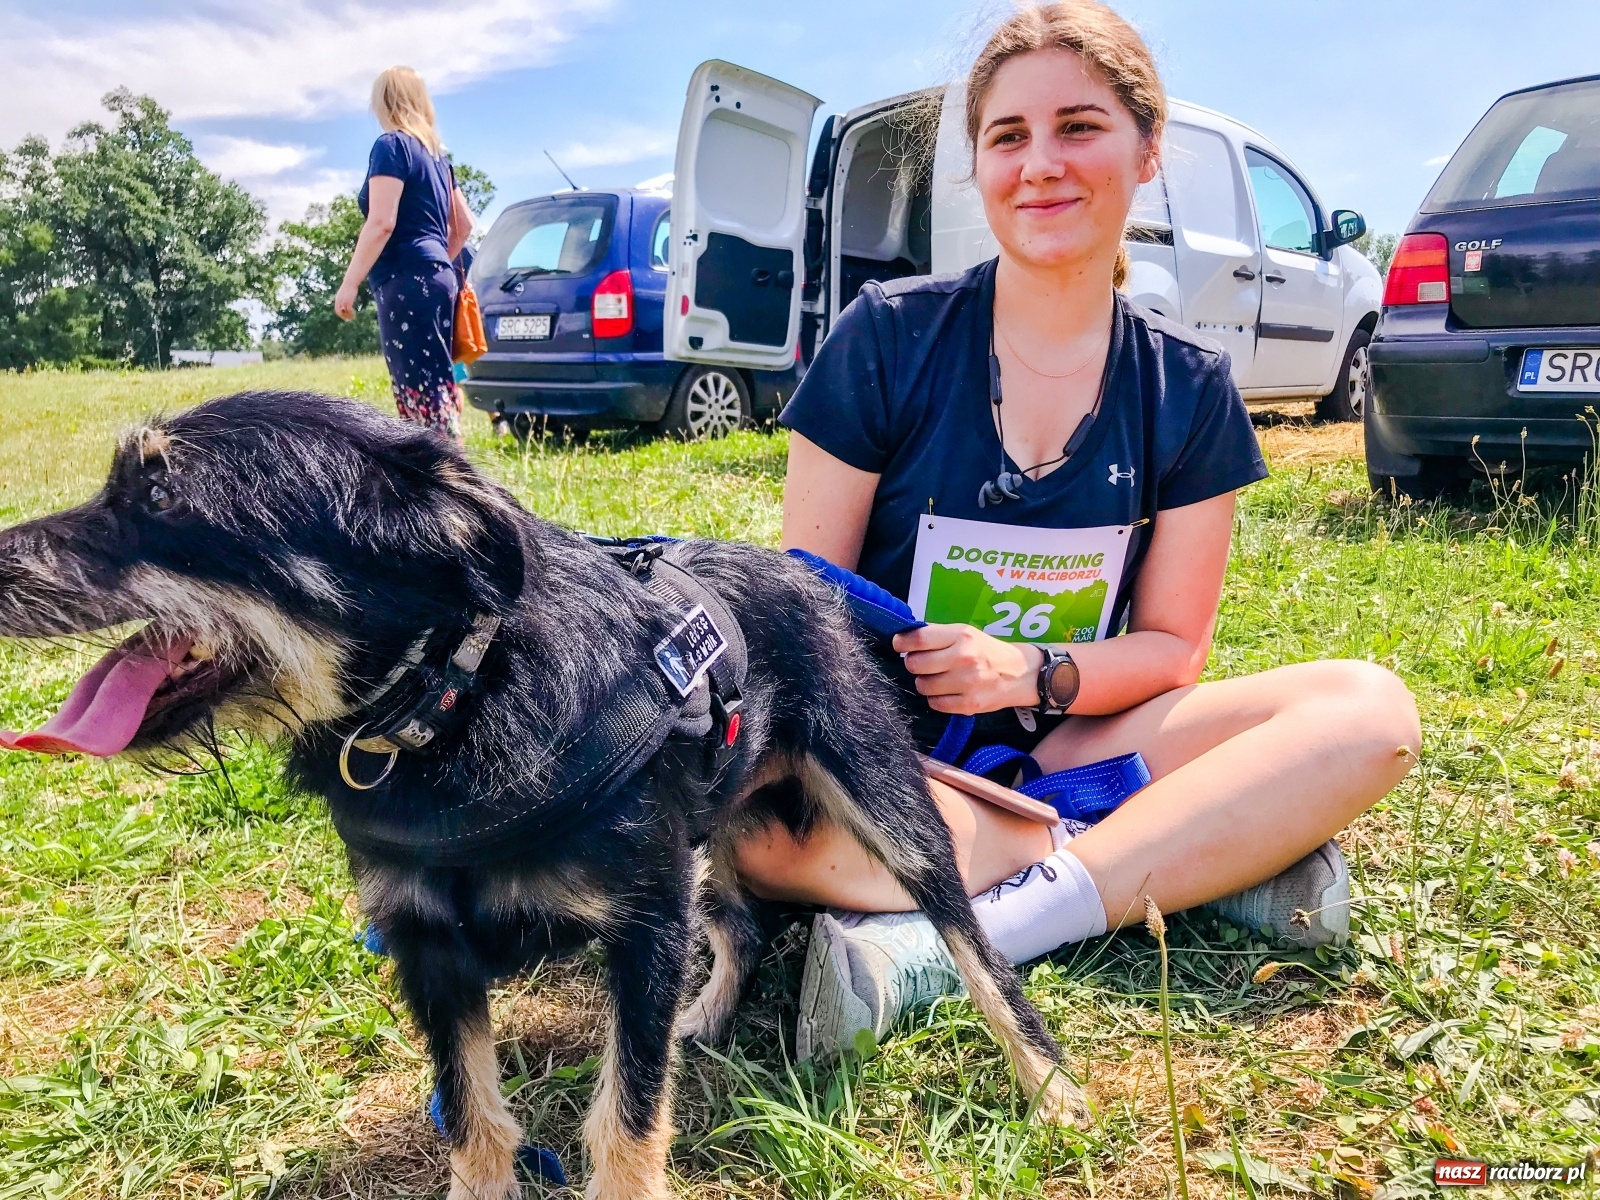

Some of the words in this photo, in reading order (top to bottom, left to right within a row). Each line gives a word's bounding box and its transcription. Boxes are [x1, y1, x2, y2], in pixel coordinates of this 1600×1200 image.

[1454, 238, 1502, 251] GOLF
[501, 318, 521, 334] SRC
[1546, 352, 1600, 382] SR
[1524, 371, 1536, 380] PL
[947, 545, 1104, 570] DOGTREKKING
[1010, 570, 1024, 580] W
[1027, 568, 1102, 581] RACIBORZU
[983, 601, 1056, 638] 26
[1075, 626, 1095, 636] ZOO
[1072, 633, 1093, 643] MAR
